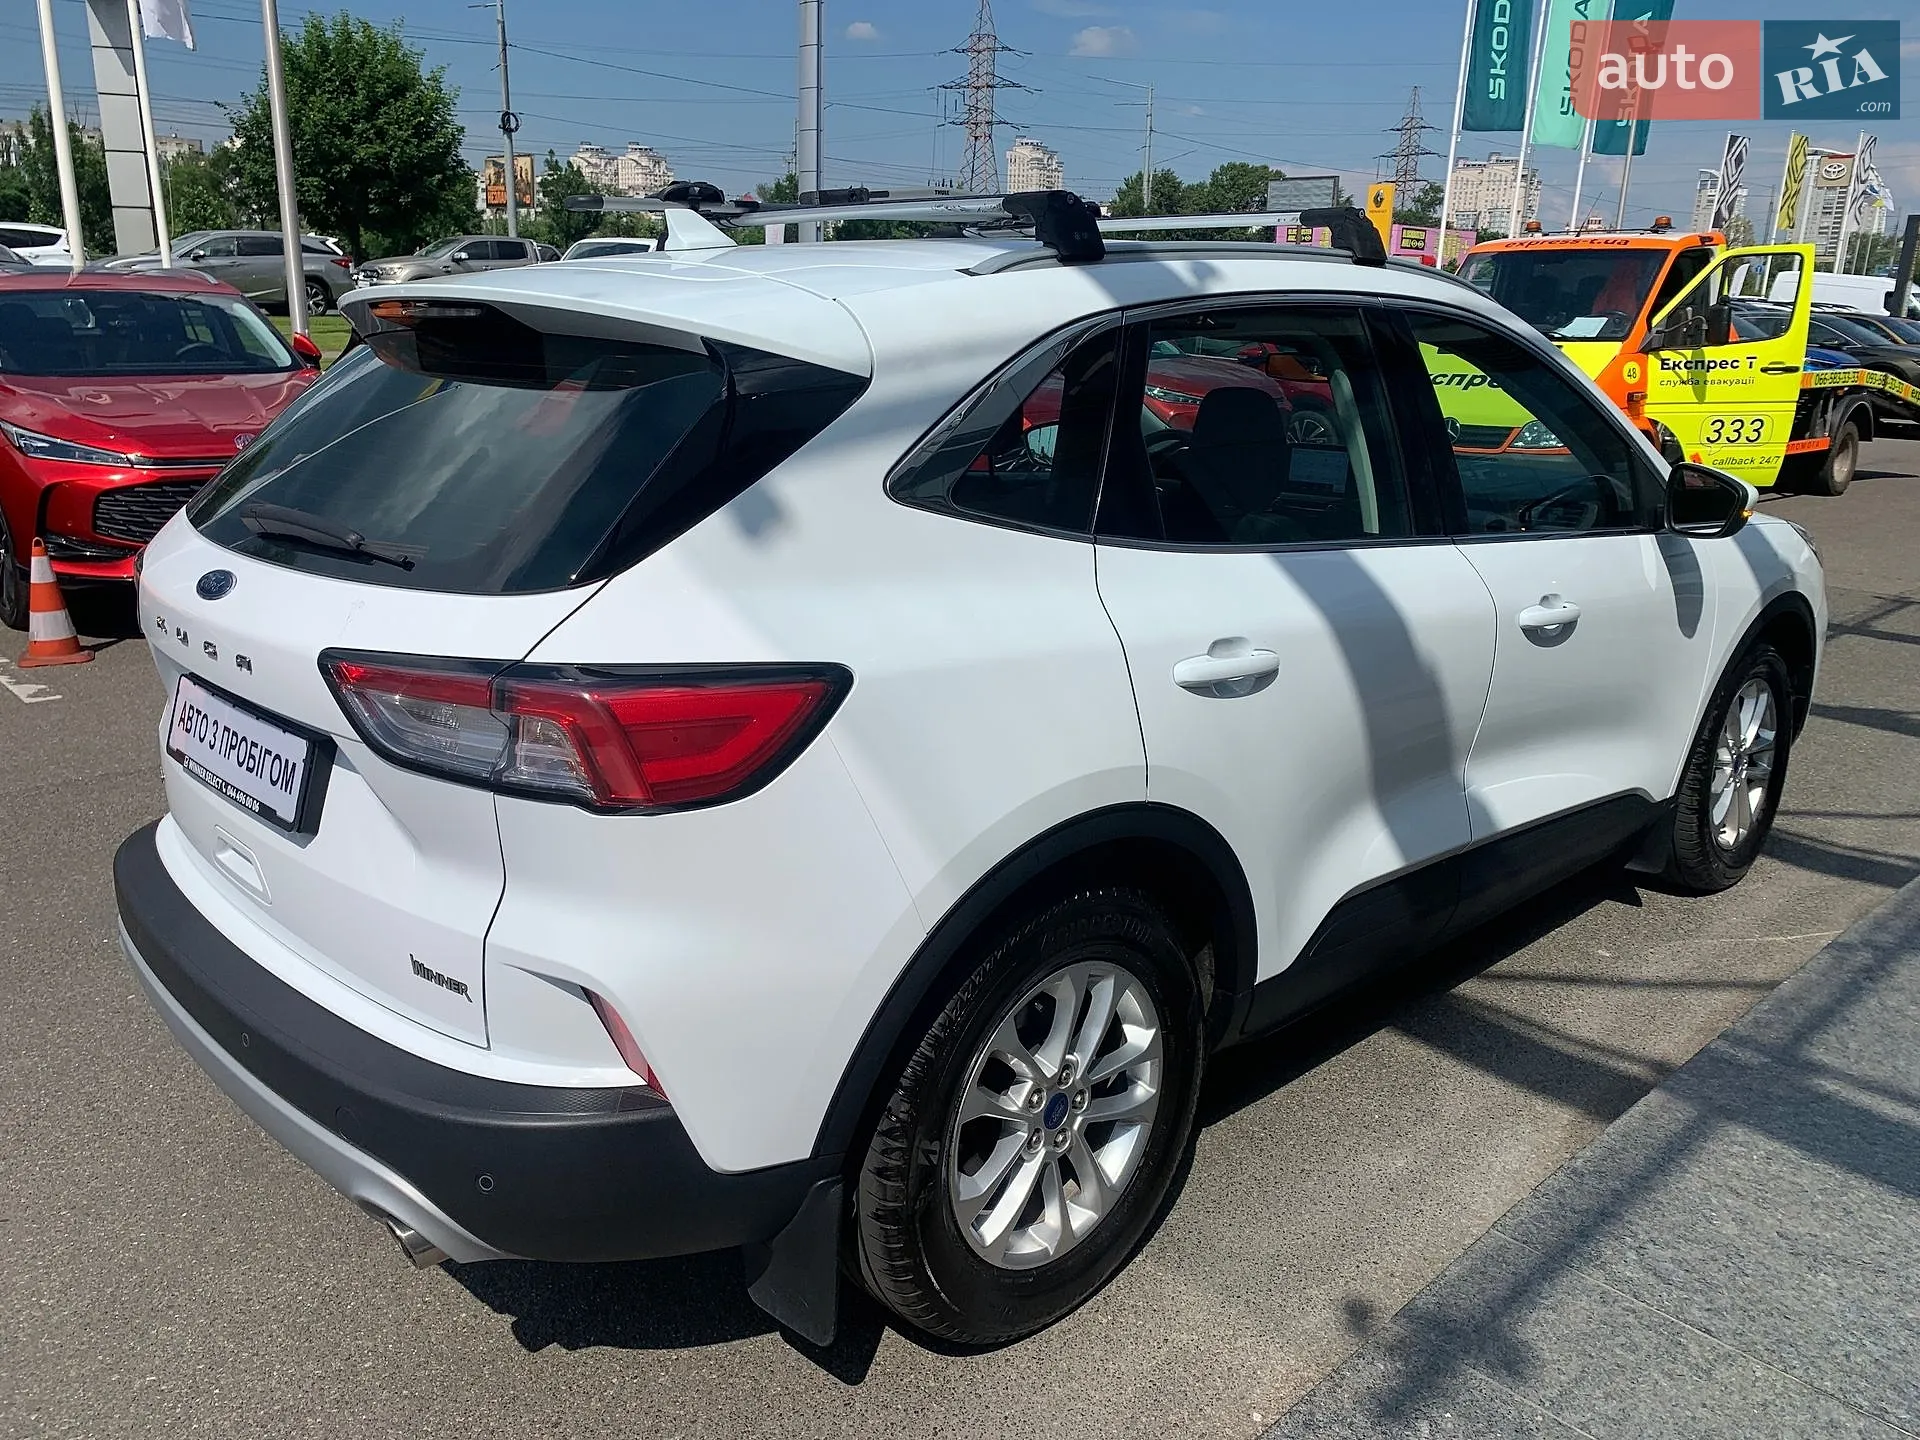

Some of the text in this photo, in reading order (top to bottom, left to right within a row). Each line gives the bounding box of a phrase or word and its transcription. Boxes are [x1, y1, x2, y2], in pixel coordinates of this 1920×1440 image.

[1504, 238, 1631, 249] express-t.ua
[1627, 367, 1637, 380] 48
[1660, 358, 1740, 372] Експрес
[1659, 377, 1701, 387] служба
[1706, 418, 1765, 444] 333
[1712, 455, 1781, 466] callback 24/7
[156, 615, 253, 675] KUGA
[178, 700, 209, 743] АВТО
[219, 725, 297, 795] ПРОБІГОМ
[189, 758, 206, 780] WINNER
[205, 771, 223, 790] SELECT
[409, 953, 473, 1003] WINNER
